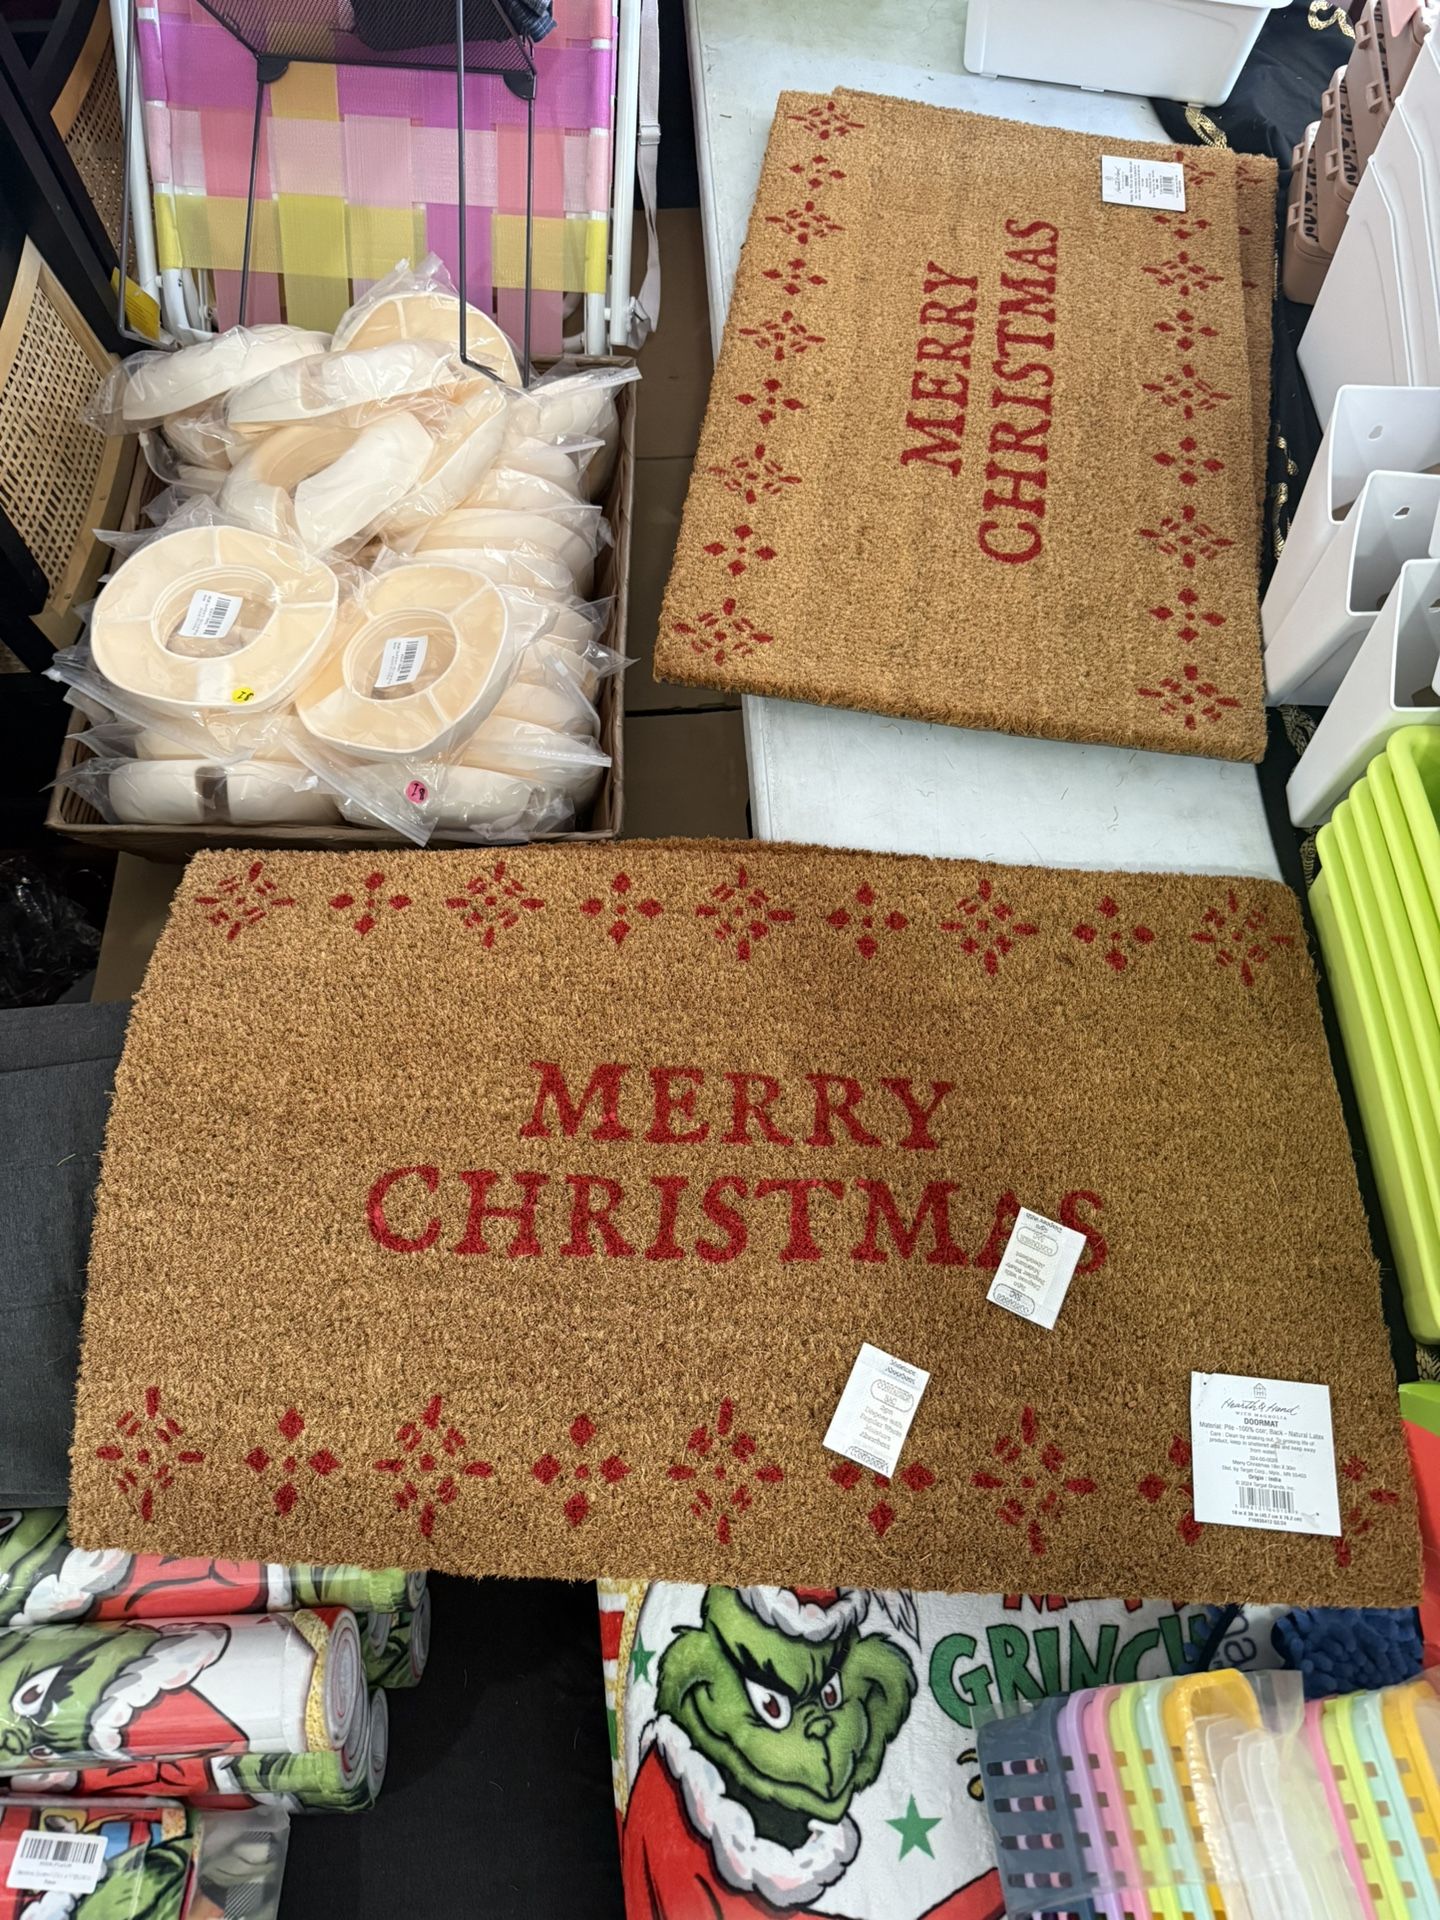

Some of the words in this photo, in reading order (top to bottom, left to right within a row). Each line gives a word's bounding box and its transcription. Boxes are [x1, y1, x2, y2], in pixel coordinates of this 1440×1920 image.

[900, 260, 978, 478] MERRY
[978, 219, 1059, 564] CHRISTMAS
[519, 1061, 956, 1151] MERRY
[1221, 1396, 1257, 1411] Hearth
[1265, 1401, 1300, 1415] Hand
[1243, 1417, 1278, 1427] DOORMAT
[930, 1614, 1205, 1728] GRINCH
